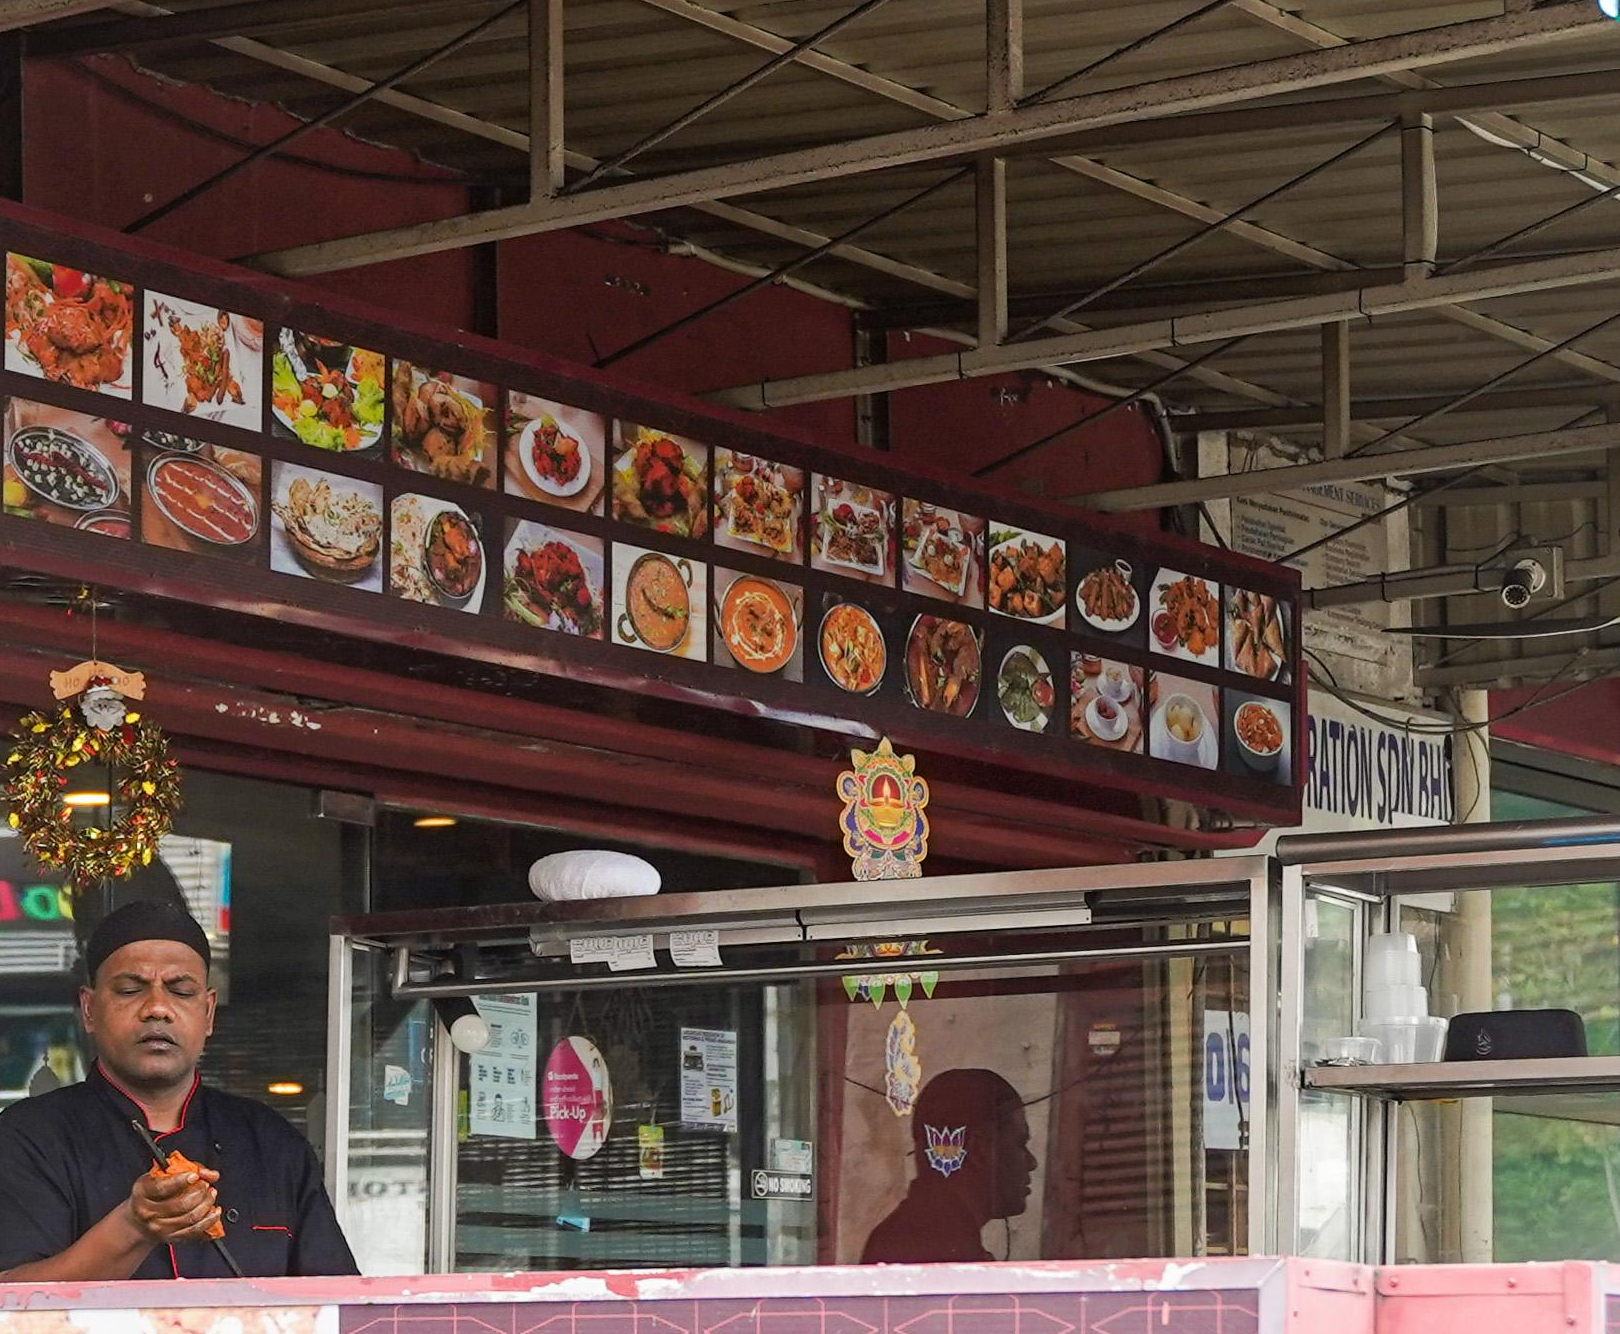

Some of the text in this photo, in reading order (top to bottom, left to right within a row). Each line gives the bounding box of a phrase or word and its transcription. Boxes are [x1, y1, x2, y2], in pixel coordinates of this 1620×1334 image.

[1307, 715, 1372, 819] RATION
[1377, 731, 1414, 825] SDN
[549, 1104, 587, 1122] Pick-Up
[769, 1177, 812, 1195] NO SMOKING
